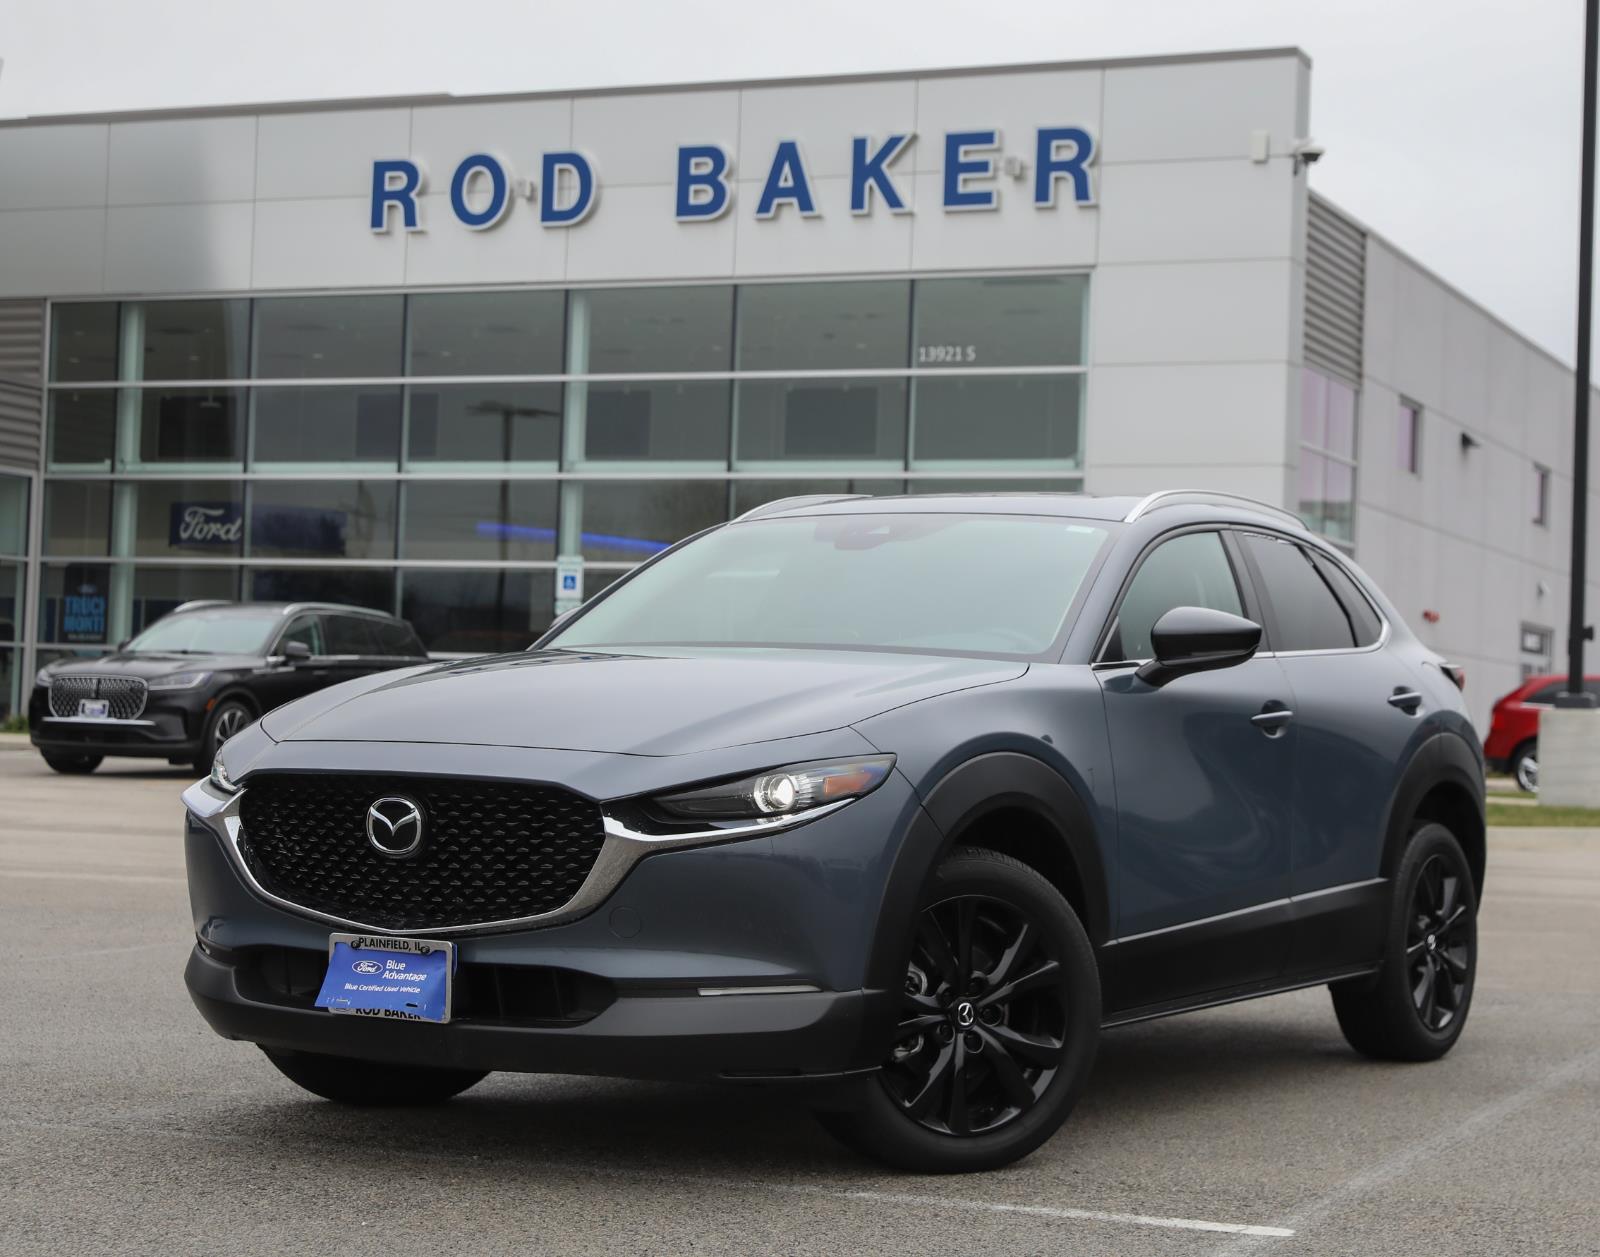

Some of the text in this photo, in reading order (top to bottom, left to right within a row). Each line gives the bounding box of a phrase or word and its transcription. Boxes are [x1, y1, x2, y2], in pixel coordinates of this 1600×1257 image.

[370, 126, 1099, 233] ROD BAKER
[920, 345, 977, 362] 13921 S
[179, 506, 243, 542] Ford
[358, 937, 411, 952] PLAINFIELD,
[356, 961, 379, 973] Ford
[386, 959, 406, 971] Blue
[382, 970, 428, 981] Advantage
[358, 984, 383, 992] Certified
[400, 986, 421, 994] Vehicle
